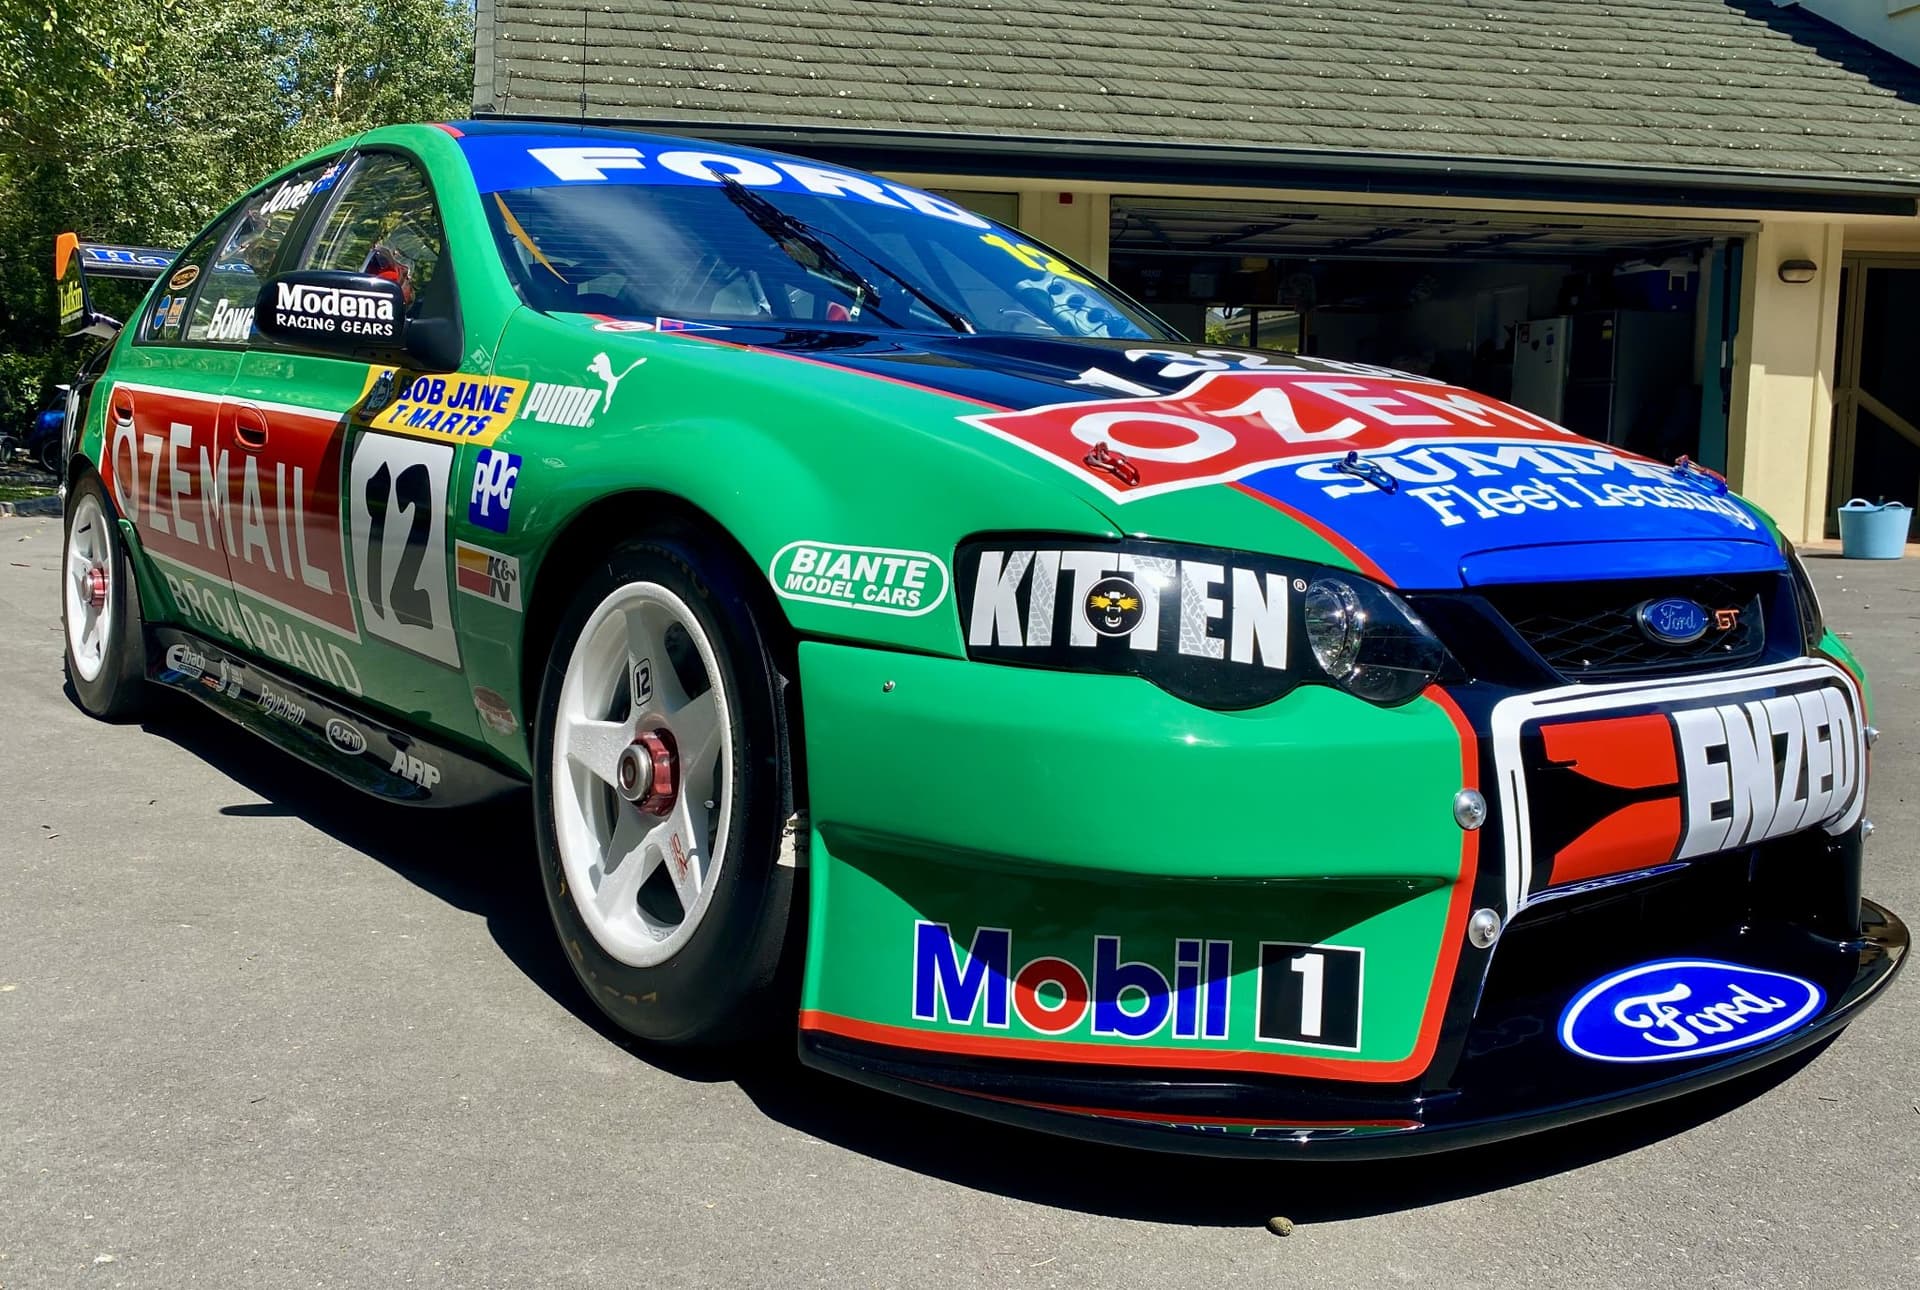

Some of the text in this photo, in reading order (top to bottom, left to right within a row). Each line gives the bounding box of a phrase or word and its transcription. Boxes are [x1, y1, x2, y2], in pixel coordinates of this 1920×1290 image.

[260, 180, 314, 215] Jone
[527, 146, 991, 230] FORD
[979, 233, 1098, 288] 12
[276, 282, 394, 320] Modena
[276, 313, 394, 336] RACING GEARS
[447, 381, 515, 415] JANE
[521, 382, 602, 428] PUMA
[1070, 382, 1576, 464] OZEM
[112, 419, 333, 596] OZEMAIL
[1405, 476, 1757, 531] Fleet Leasing
[365, 461, 434, 631] 12
[790, 547, 930, 590] BIANTE
[784, 573, 921, 608] MODEL CARS
[969, 550, 1288, 671] KITTEN
[165, 572, 364, 698] BROADBAND
[1660, 604, 1740, 631] Ford GT
[257, 683, 306, 725] Raychem
[636, 666, 651, 699] 12
[390, 750, 441, 790] ARP
[1671, 686, 1856, 861] ENZED
[912, 919, 1324, 1040] Mobil 1
[1614, 983, 1787, 1048] Ford
